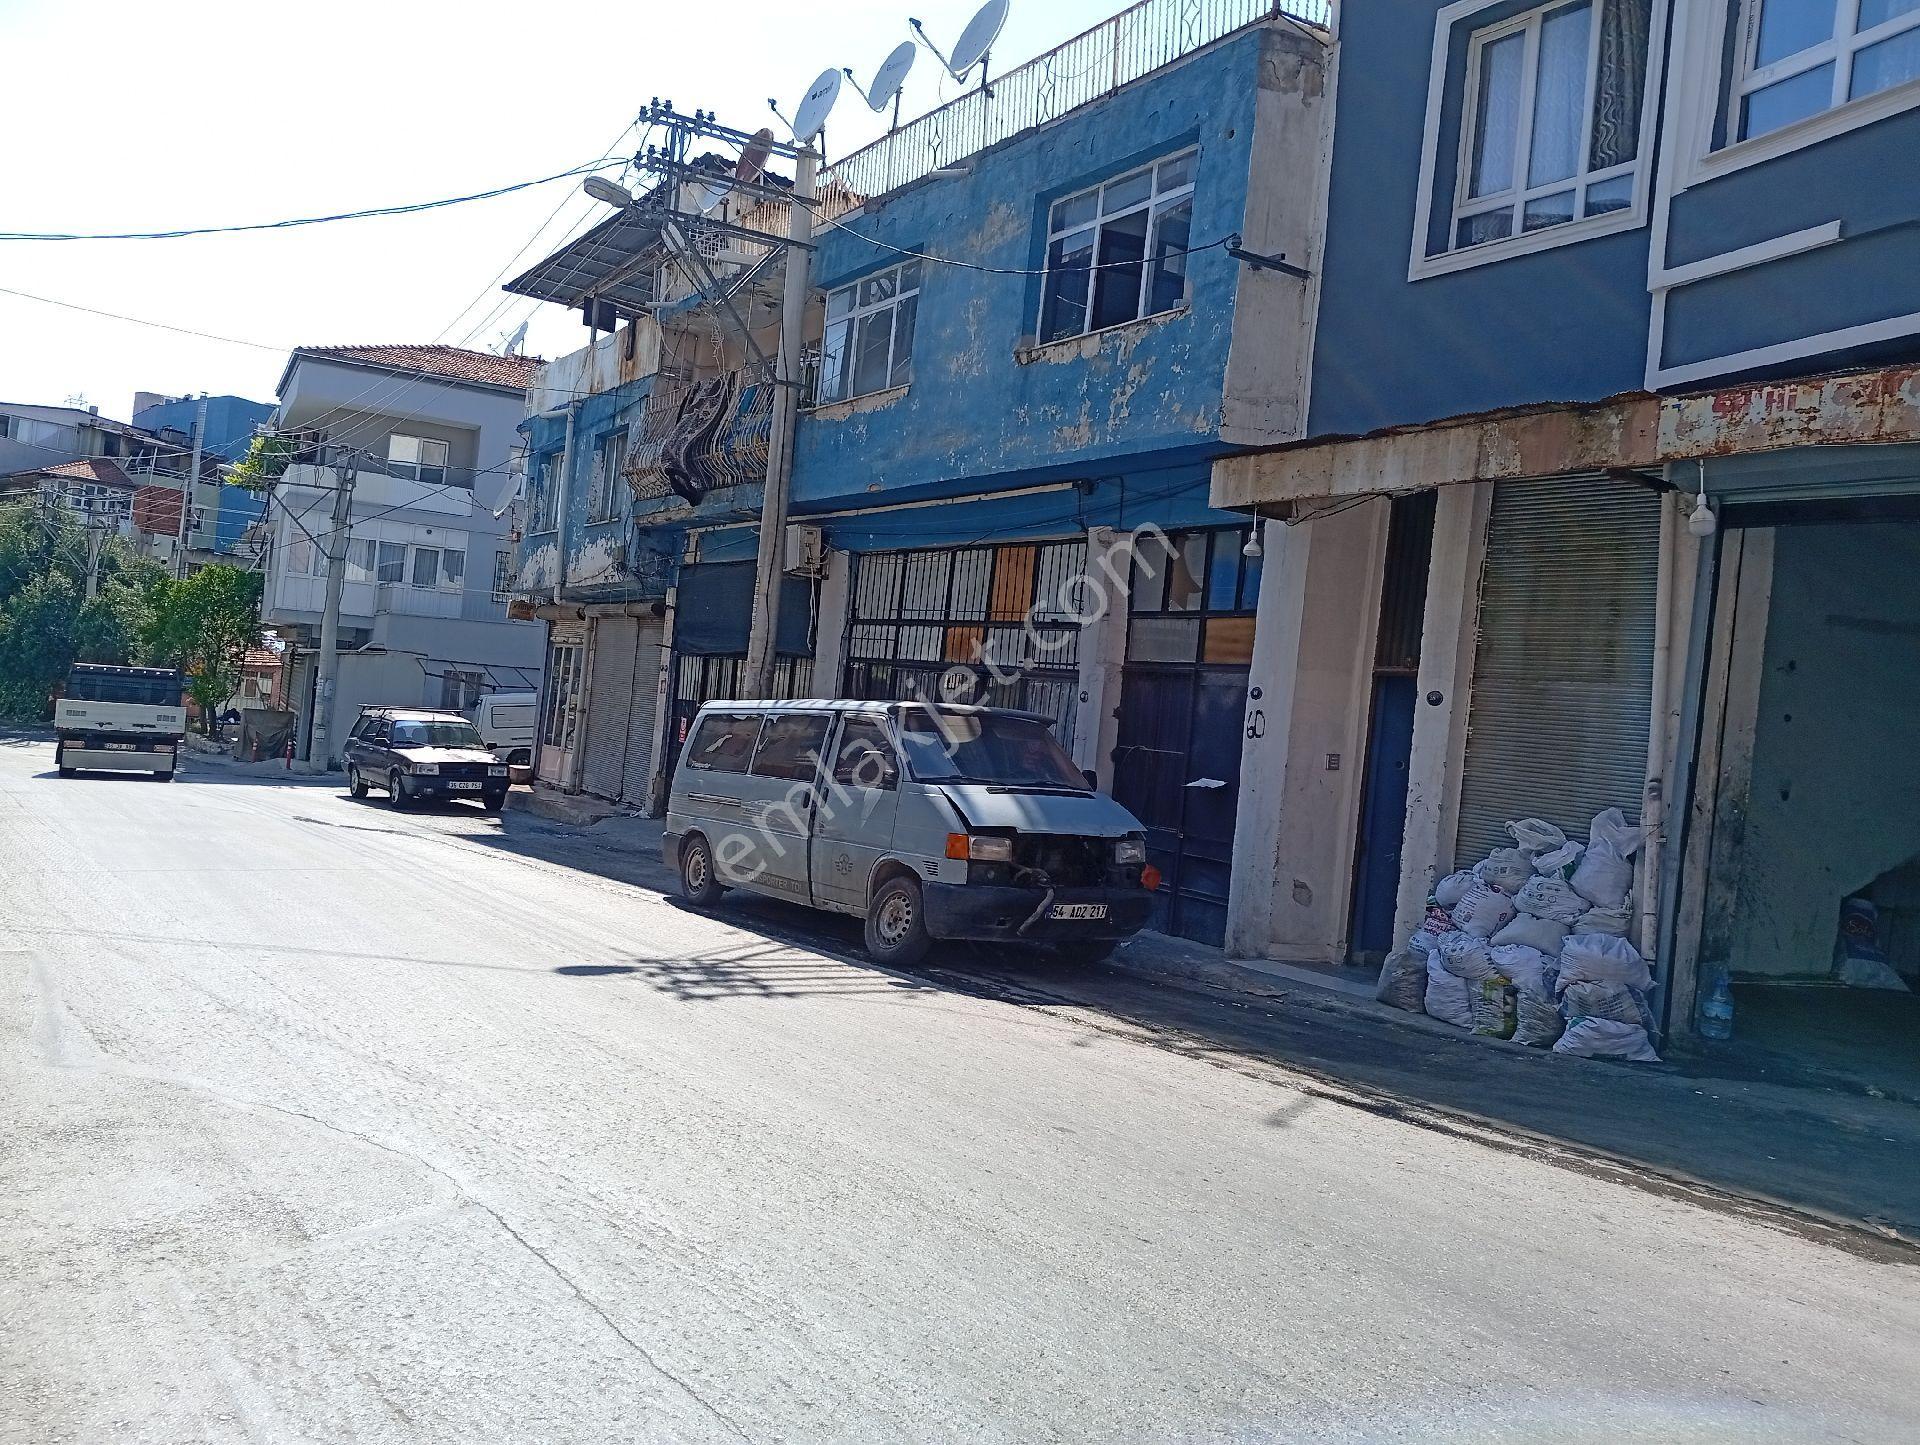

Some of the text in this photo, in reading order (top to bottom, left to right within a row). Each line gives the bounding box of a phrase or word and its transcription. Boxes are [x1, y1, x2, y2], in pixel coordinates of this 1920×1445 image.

[1052, 905, 1107, 918] 54 ADZ 217
